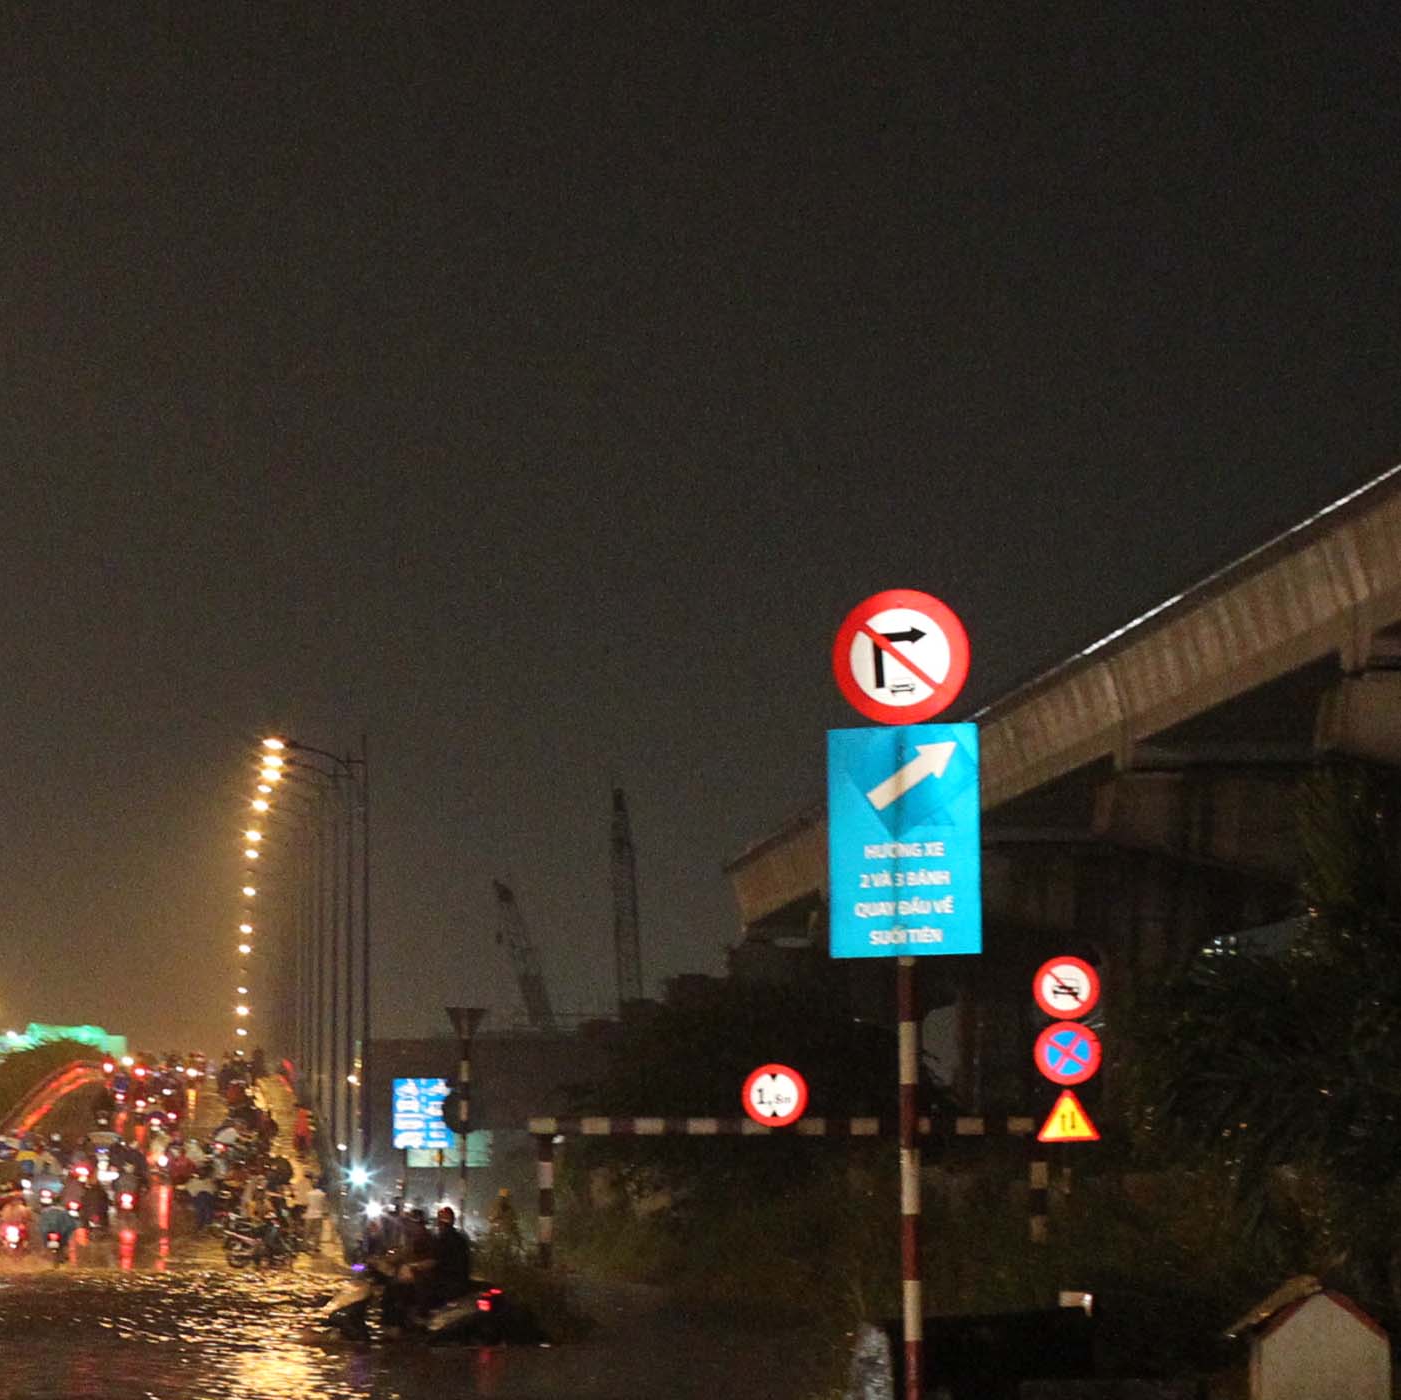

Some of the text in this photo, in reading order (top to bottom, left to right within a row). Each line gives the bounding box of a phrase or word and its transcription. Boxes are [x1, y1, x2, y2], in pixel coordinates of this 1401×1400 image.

[924, 841, 944, 856] XE
[860, 873, 871, 888] 2
[895, 872, 905, 887] 3
[906, 868, 951, 886] BÁNH
[855, 902, 896, 918] QUAY
